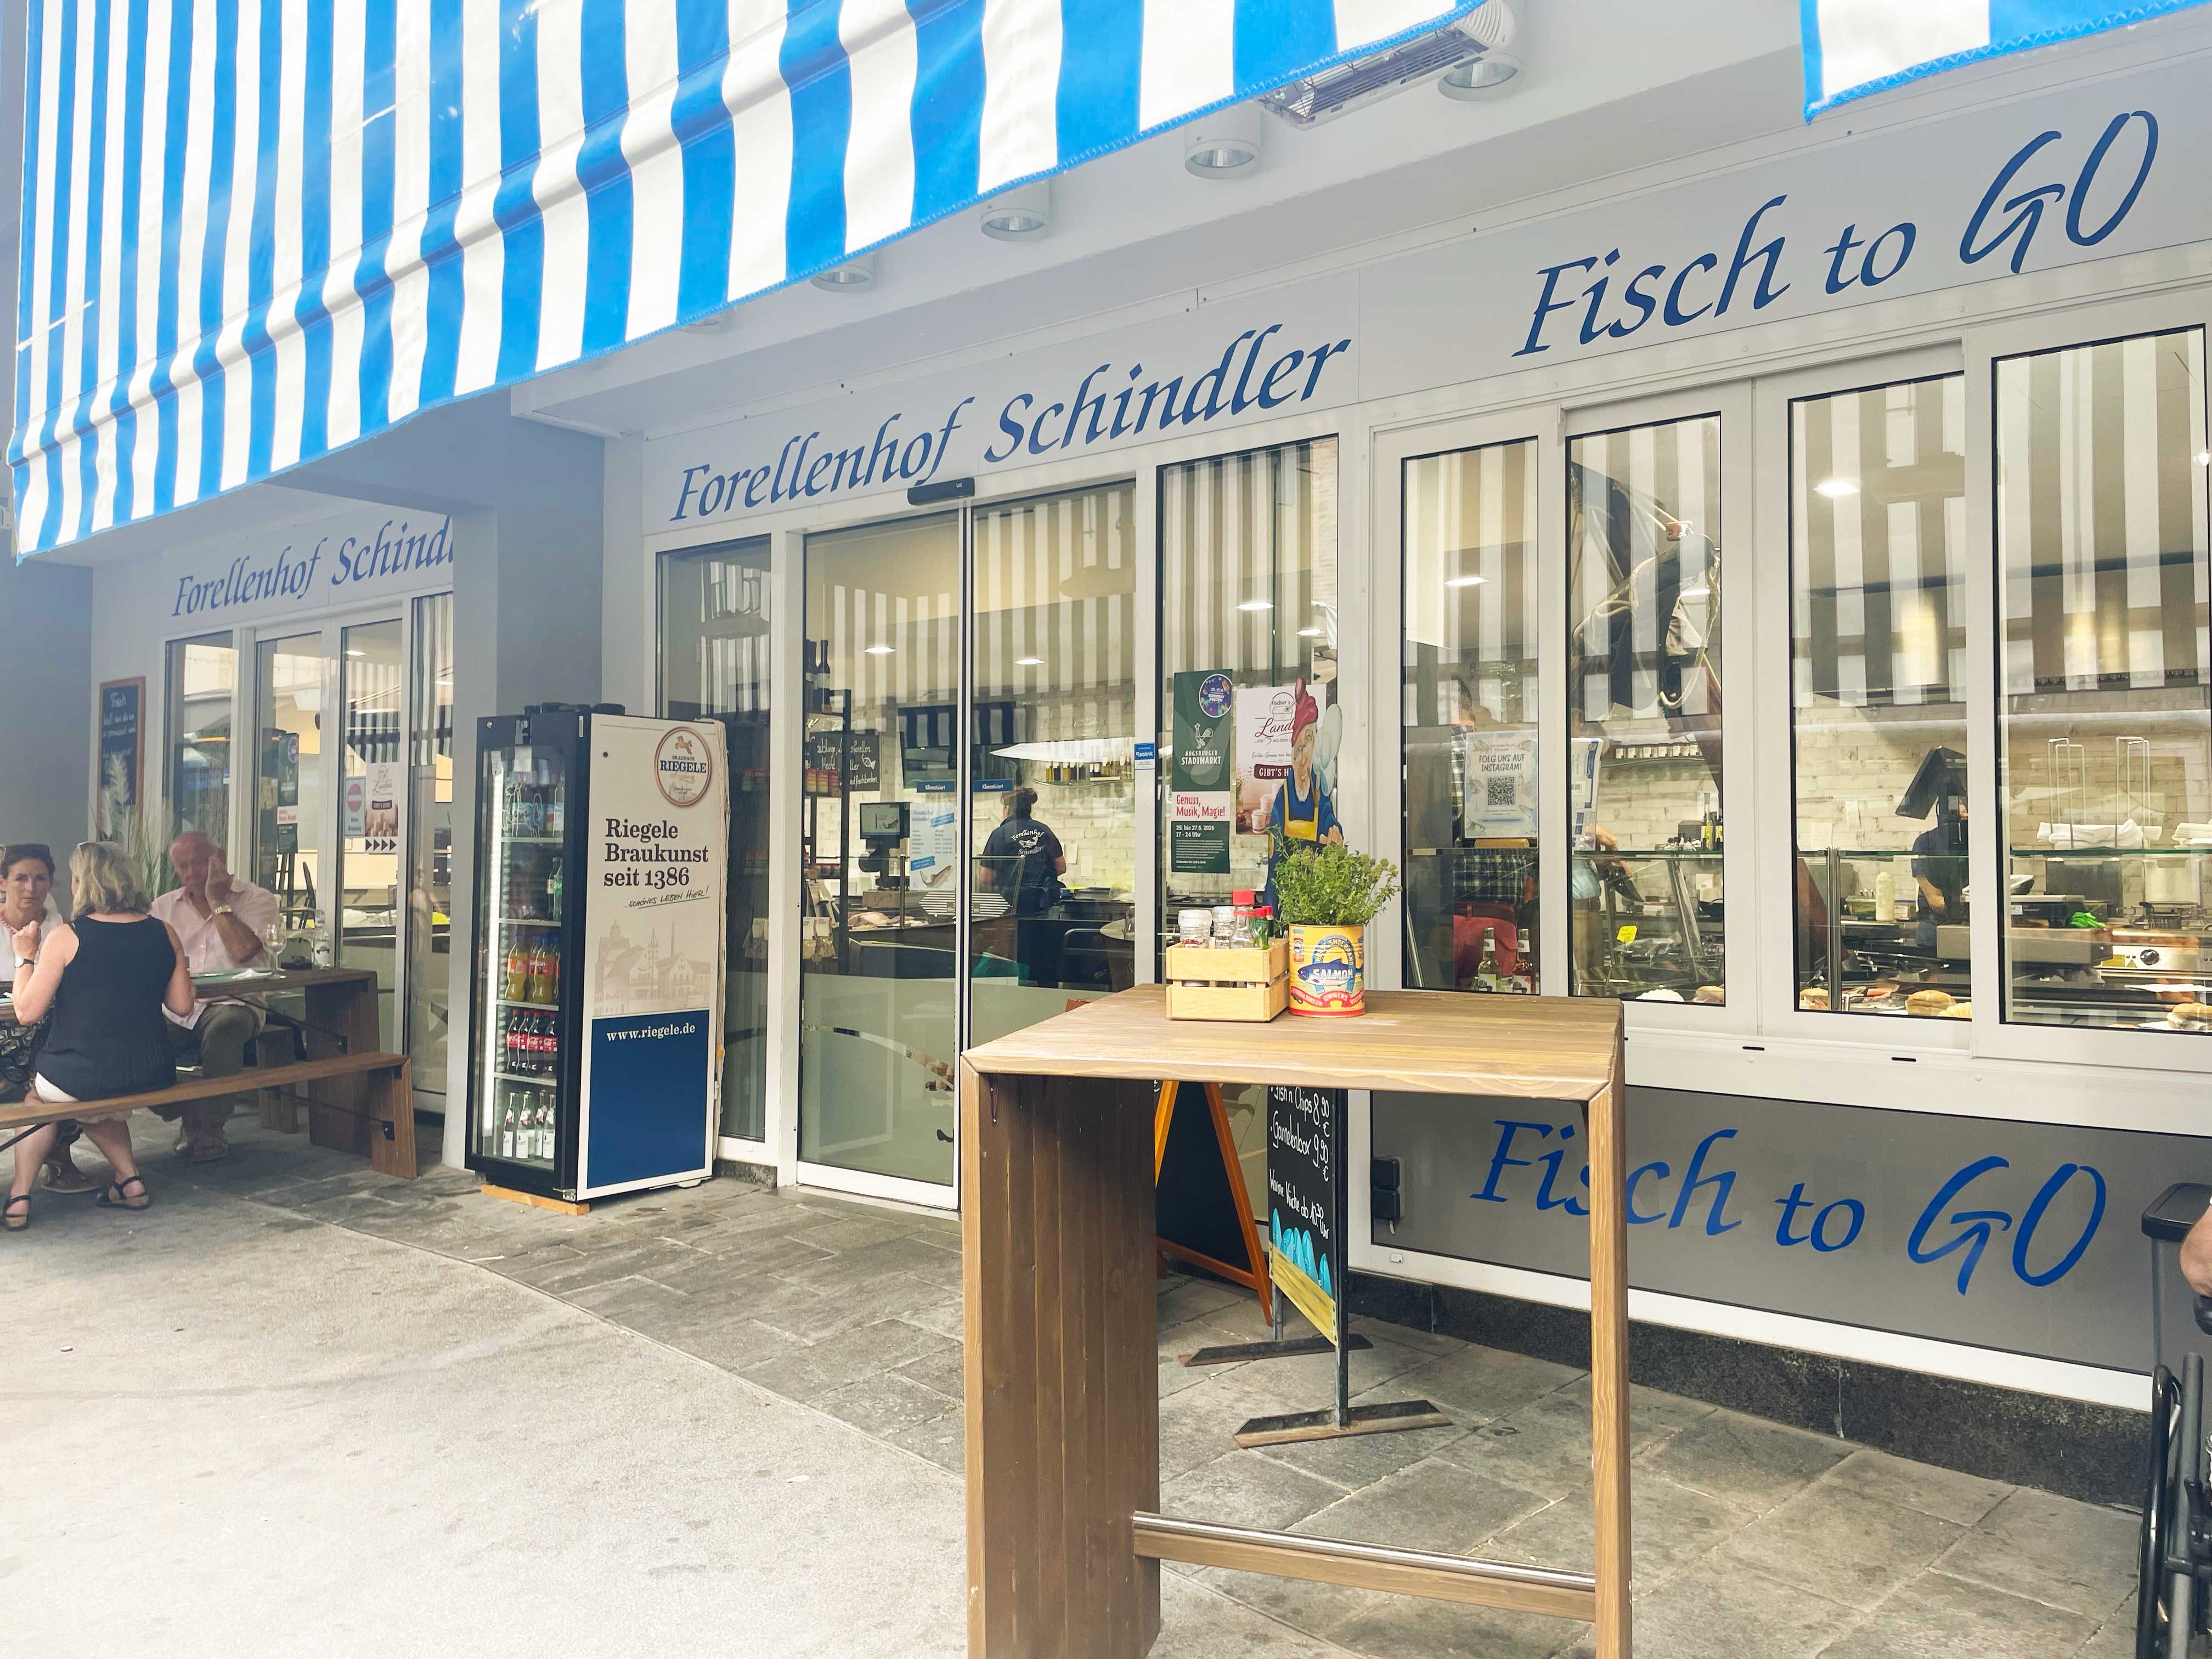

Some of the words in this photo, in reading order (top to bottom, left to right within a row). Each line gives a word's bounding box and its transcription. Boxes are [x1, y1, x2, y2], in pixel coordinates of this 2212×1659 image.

[1511, 195, 1790, 357] Fisch
[1824, 223, 1916, 295] to
[1960, 110, 2159, 273] GO
[669, 396, 975, 521] Forellenhof
[984, 324, 1351, 462] Schindler
[172, 537, 328, 616] Forellenhof
[331, 516, 453, 585] Schind
[1255, 718, 1295, 737] Land
[660, 760, 707, 773] RIEGELE
[1181, 757, 1221, 765] STADTMARKT
[1479, 754, 1496, 763] FOLG
[1498, 754, 1510, 763] UNS
[1513, 753, 1525, 761] AUF
[1259, 768, 1282, 777] GIBT'S
[1481, 763, 1522, 772] INSTAGRAM!
[1176, 794, 1201, 806] Genuss,
[1176, 806, 1200, 819] Musik,
[1202, 806, 1225, 819] Magie!
[606, 819, 678, 843] Riegele
[605, 842, 709, 862] Braukunst
[603, 867, 639, 887] seit
[645, 867, 690, 889] 1386
[661, 892, 683, 902] LEBEN
[1313, 968, 1353, 980] SALMON
[1323, 992, 1348, 1002] OWNERS
[606, 1023, 695, 1041] www.riegele.de
[1295, 1086, 1312, 1122] Chips
[1273, 1110, 1312, 1155] Garnelenbox
[1775, 1183, 1865, 1252] to
[1908, 1156, 2106, 1296] GO
